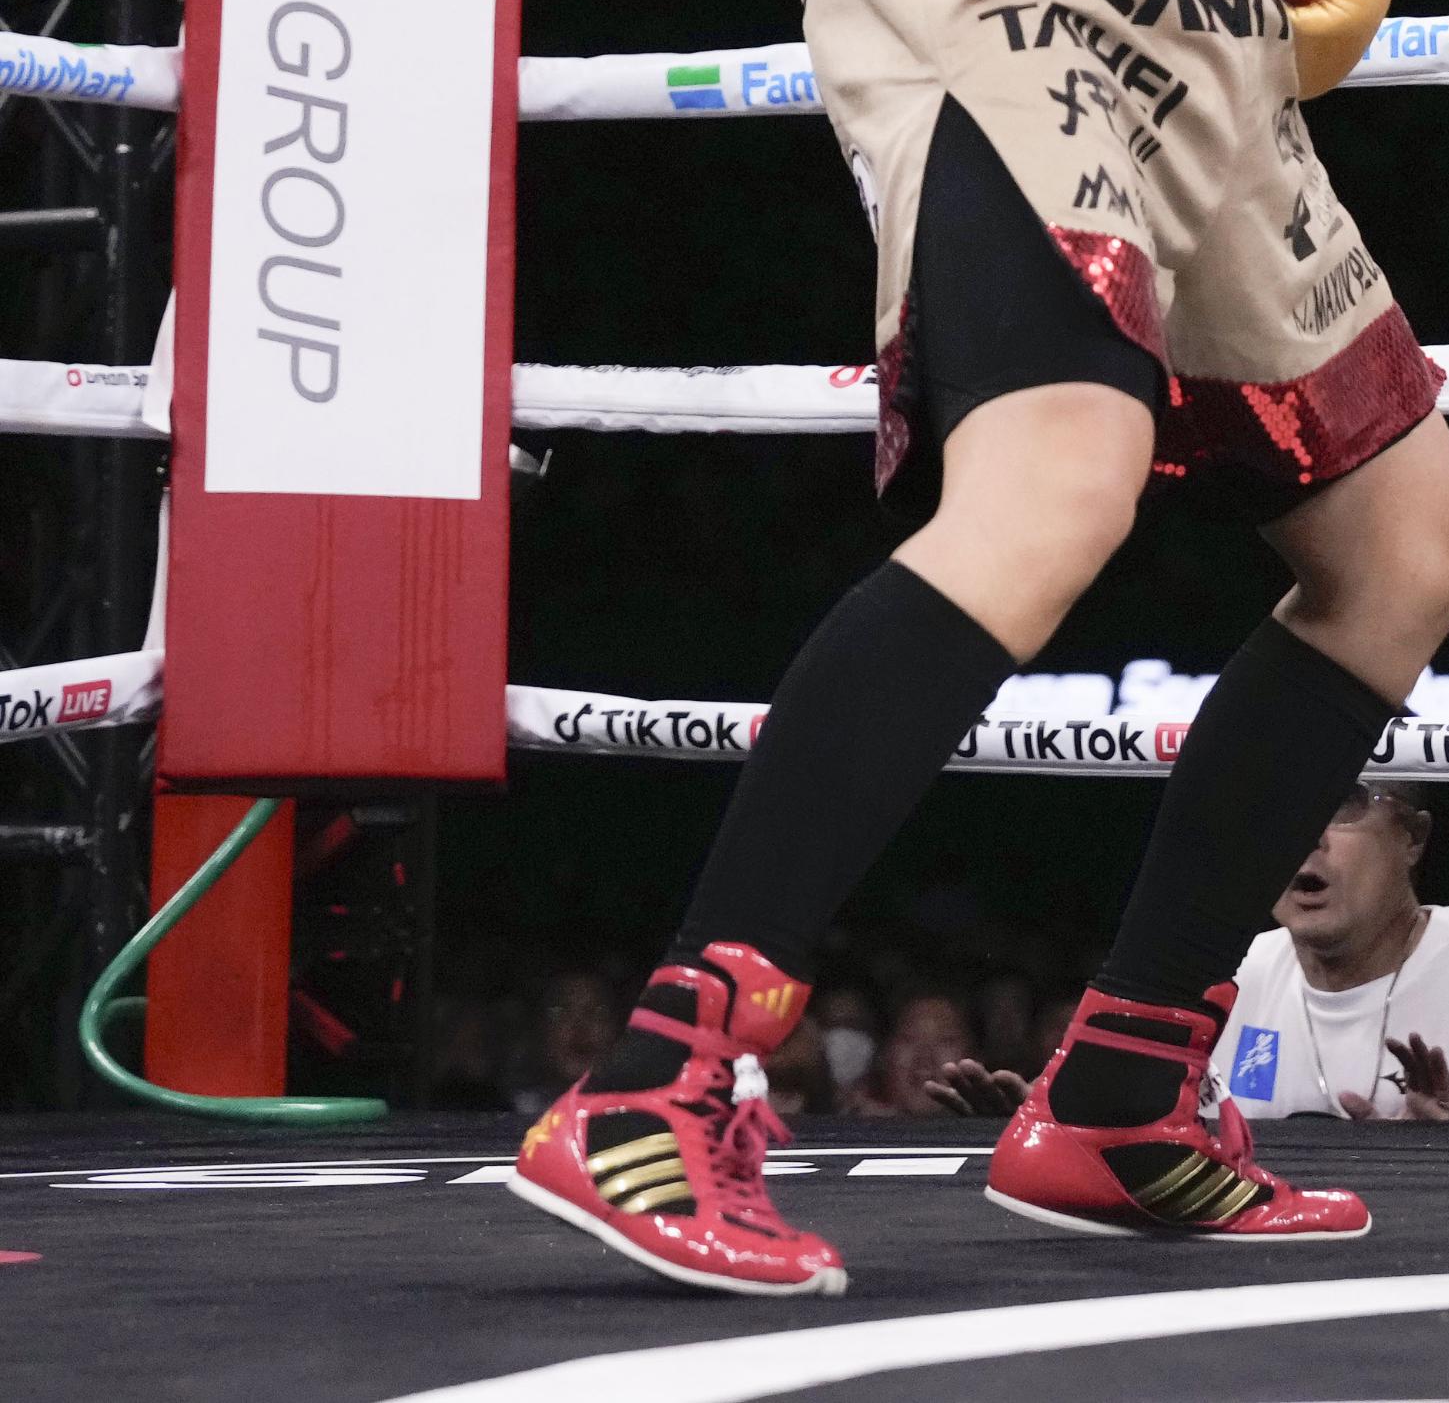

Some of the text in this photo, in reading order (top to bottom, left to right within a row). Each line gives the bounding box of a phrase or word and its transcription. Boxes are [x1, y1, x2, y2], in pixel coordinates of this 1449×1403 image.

[258, 1, 351, 403] GROUP
[63, 688, 108, 716] LIVE
[601, 710, 744, 751] TikTok
[999, 720, 1148, 762] TikTok
